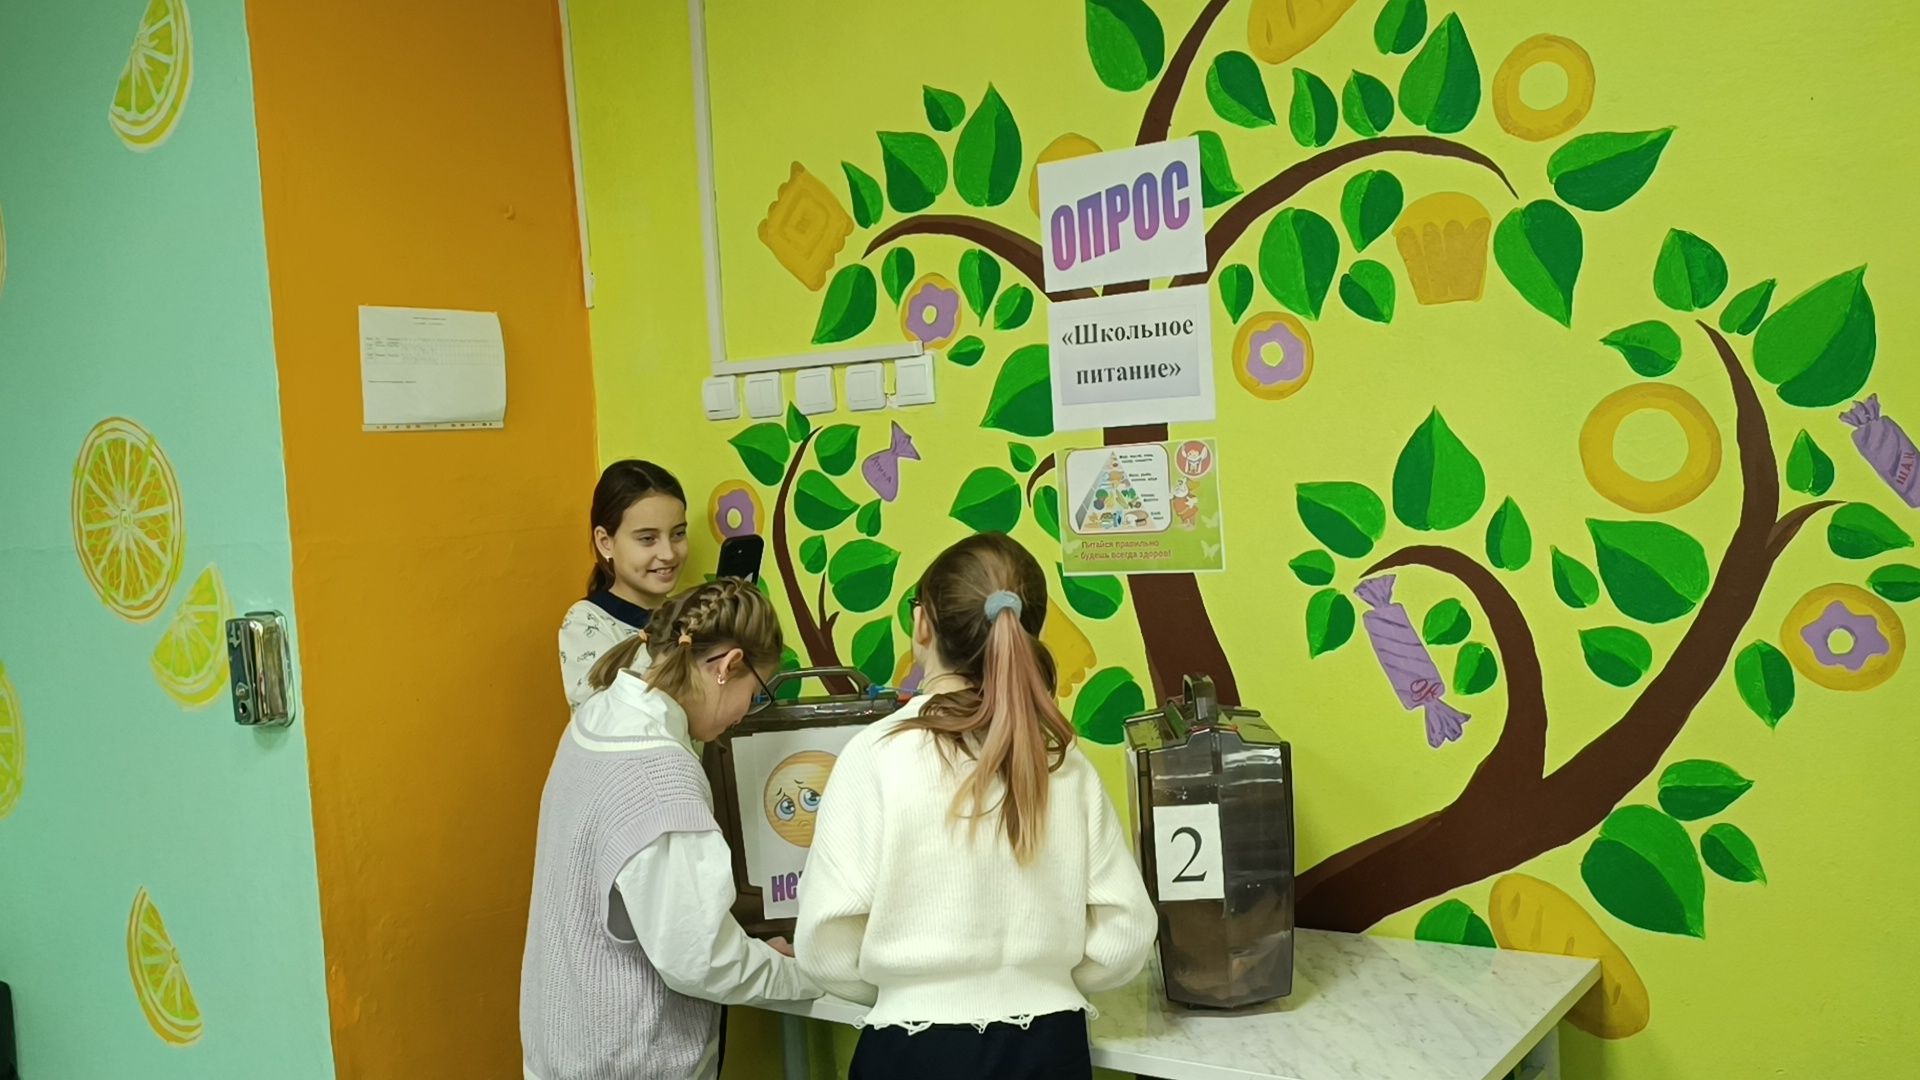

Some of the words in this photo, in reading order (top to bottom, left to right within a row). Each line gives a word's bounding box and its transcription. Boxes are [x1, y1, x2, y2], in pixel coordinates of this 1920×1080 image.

[1050, 160, 1191, 272] ОПРОС
[1061, 318, 1194, 346] «Школьное
[1076, 362, 1182, 385] питание»
[1080, 551, 1110, 560] будешь
[1111, 551, 1138, 560] всегда
[1139, 549, 1171, 559] здоров!
[1081, 540, 1113, 549] Питайся
[1115, 540, 1160, 550] правильно
[1170, 826, 1208, 884] 2
